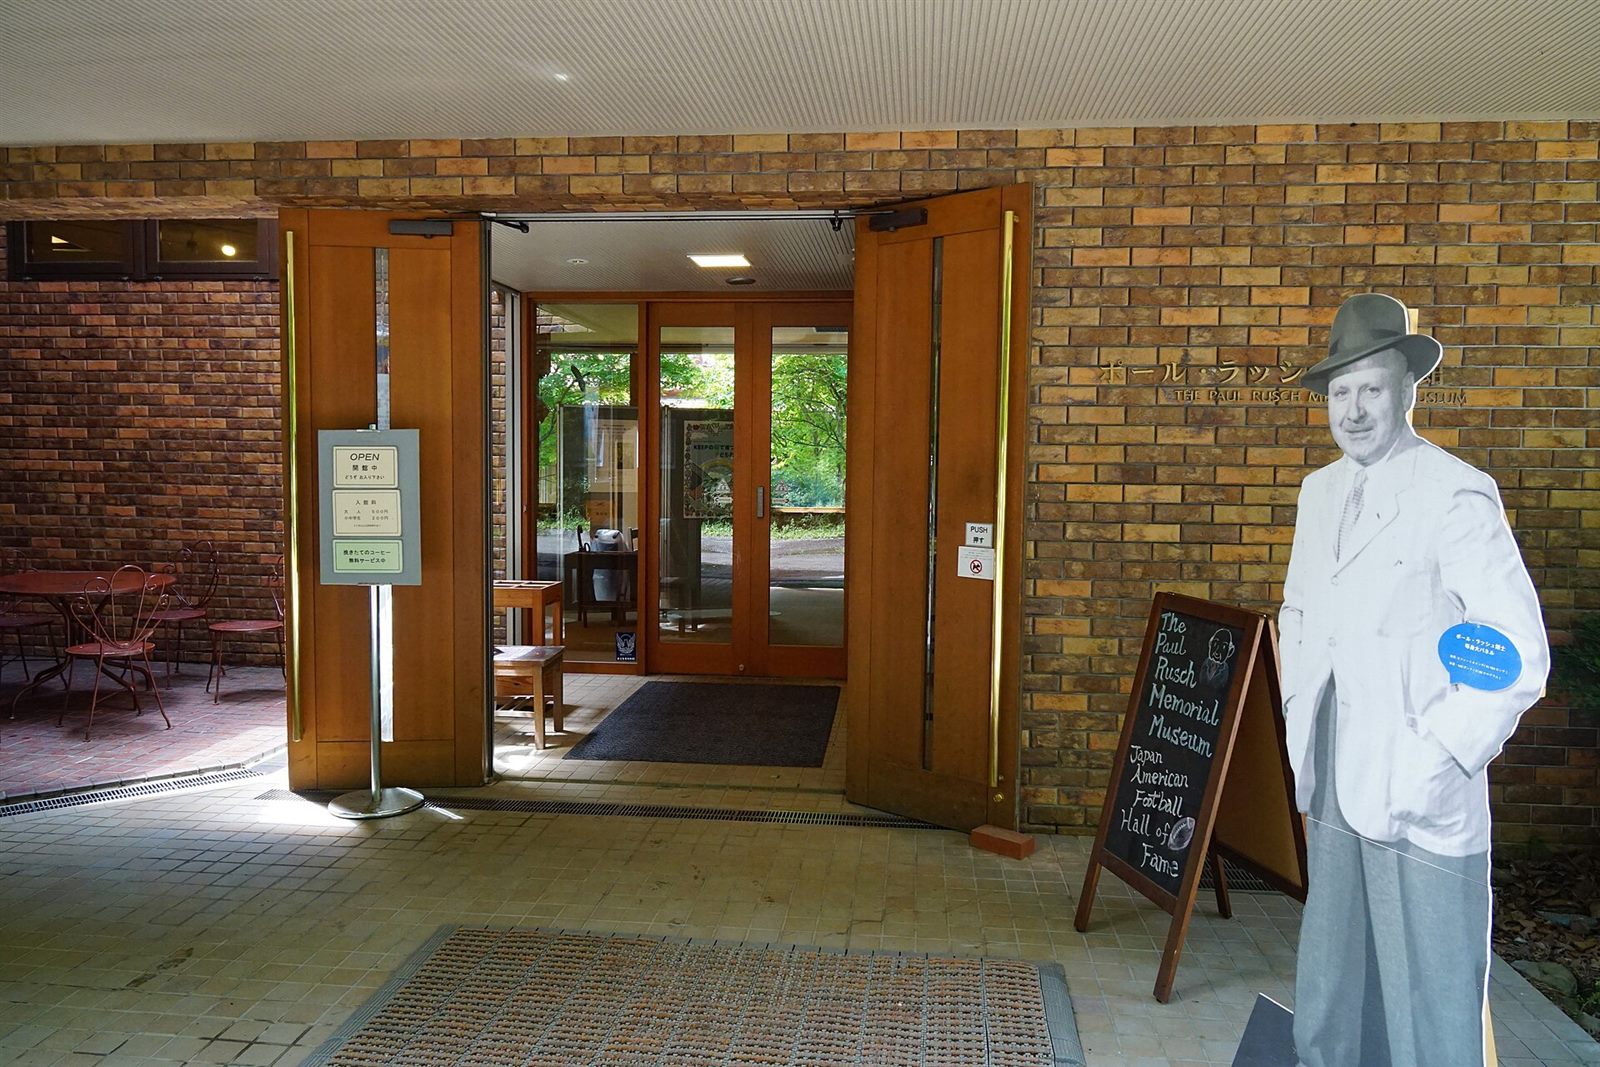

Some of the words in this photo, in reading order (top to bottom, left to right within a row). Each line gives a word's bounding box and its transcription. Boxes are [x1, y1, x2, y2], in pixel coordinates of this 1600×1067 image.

[1100, 360, 1304, 384] ポール・ラッシ
[1175, 390, 1201, 402] THE
[1209, 390, 1242, 402] PAUL
[1252, 390, 1301, 402] RUSCH
[1417, 391, 1467, 404] USEUM
[350, 452, 380, 461] OPEN
[970, 525, 988, 534] PUSH
[1162, 612, 1187, 634] The
[1155, 632, 1187, 655] Paul
[1154, 656, 1197, 688] Rusch
[1149, 683, 1219, 726] Memorial
[1149, 714, 1212, 758] Museum
[1130, 744, 1163, 766] Japan
[1130, 763, 1189, 788] American
[1132, 789, 1183, 818] Football
[1120, 807, 1151, 837] Hall
[1155, 822, 1171, 845] of
[1140, 842, 1179, 877] Fame
